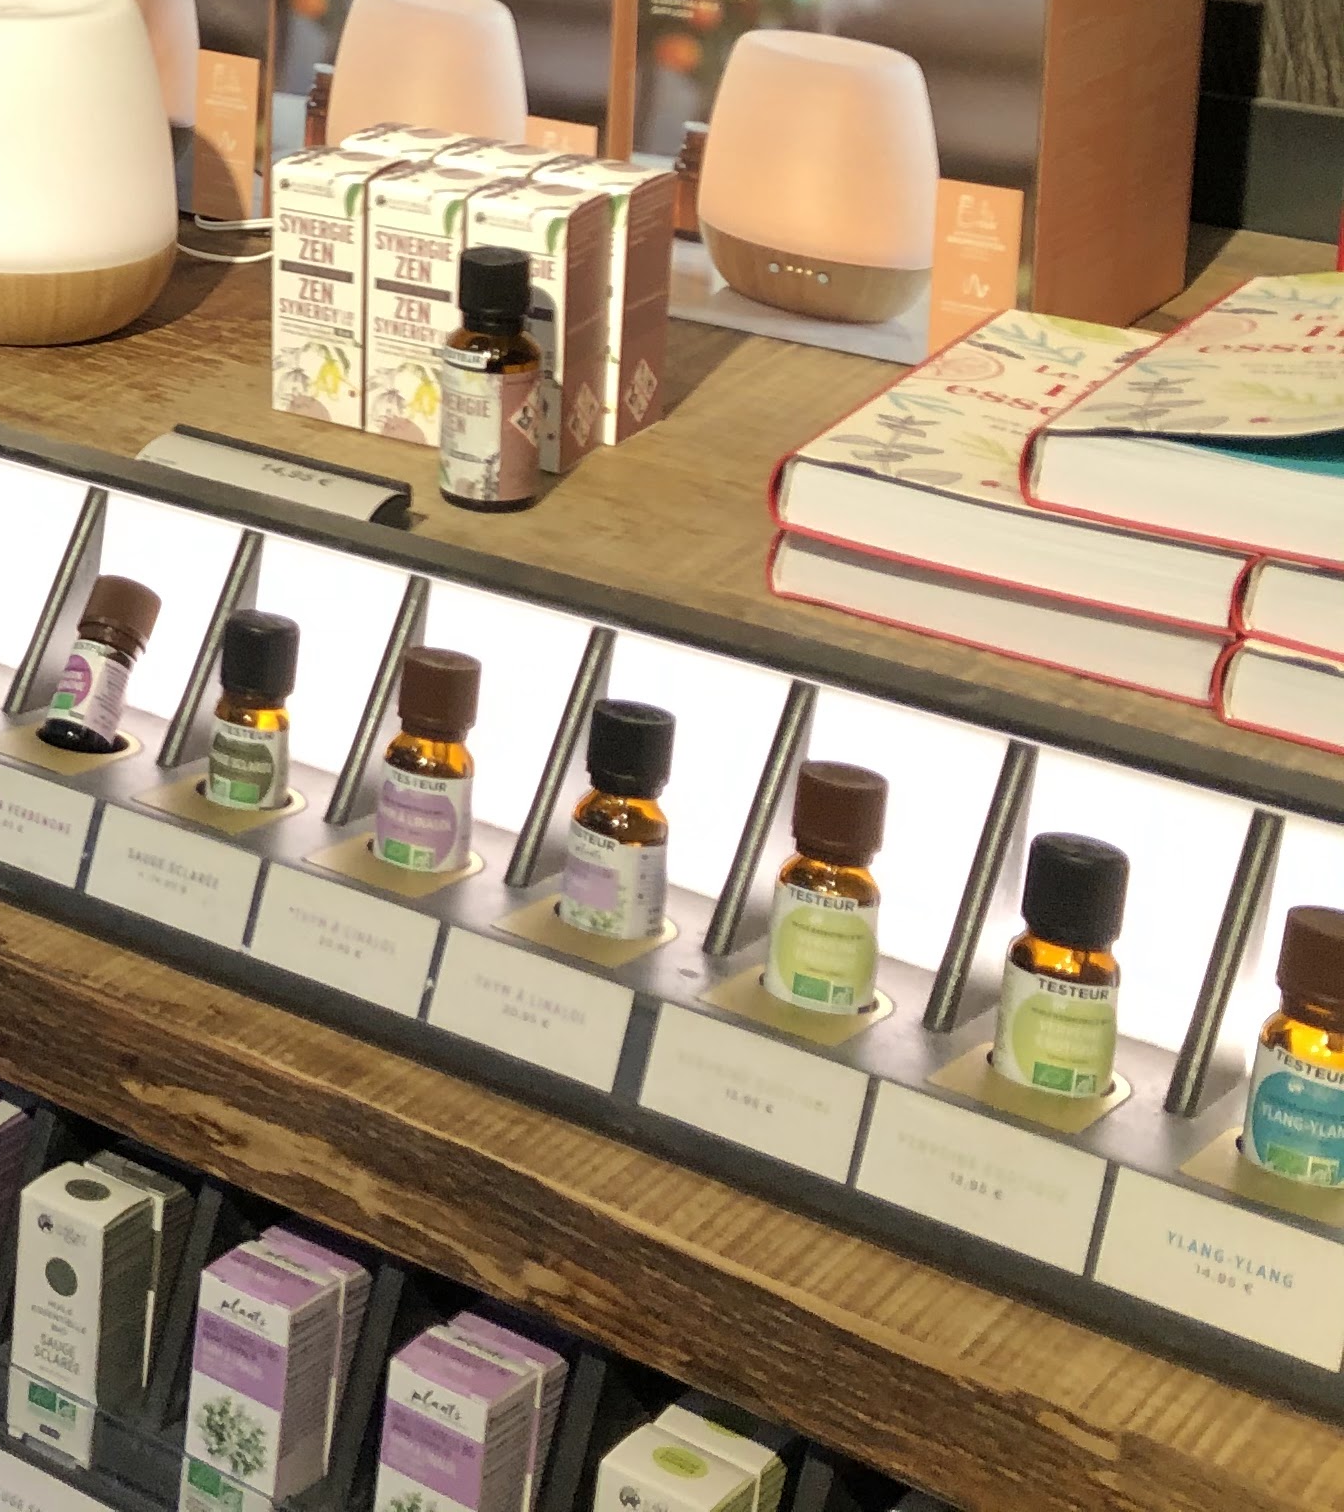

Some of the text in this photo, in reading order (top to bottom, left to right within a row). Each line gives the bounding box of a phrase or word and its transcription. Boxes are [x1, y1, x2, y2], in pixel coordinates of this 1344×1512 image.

[279, 214, 355, 246] SYNERGIE
[297, 236, 336, 266] ZEN
[373, 232, 454, 264] SYNERGIE
[394, 256, 433, 285] ZEN
[297, 279, 335, 308] ZEN
[278, 296, 337, 325] SYNERGY
[394, 297, 433, 328] ZEN
[373, 316, 434, 346] SYNERGY
[318, 478, 333, 486] €
[392, 769, 447, 793] TESTEUR
[17, 824, 24, 833] €
[788, 886, 856, 913] TESTEUR
[1037, 975, 1110, 1002] TESTEUR
[542, 1018, 550, 1029] €
[765, 1103, 774, 1114] €
[993, 1187, 1004, 1202] €
[1165, 1229, 1295, 1290] YLANG-YLANG
[1243, 1281, 1255, 1297] €
[220, 1297, 266, 1329] plants
[40, 1333, 76, 1358] SAUGE
[411, 1388, 462, 1421] plants
